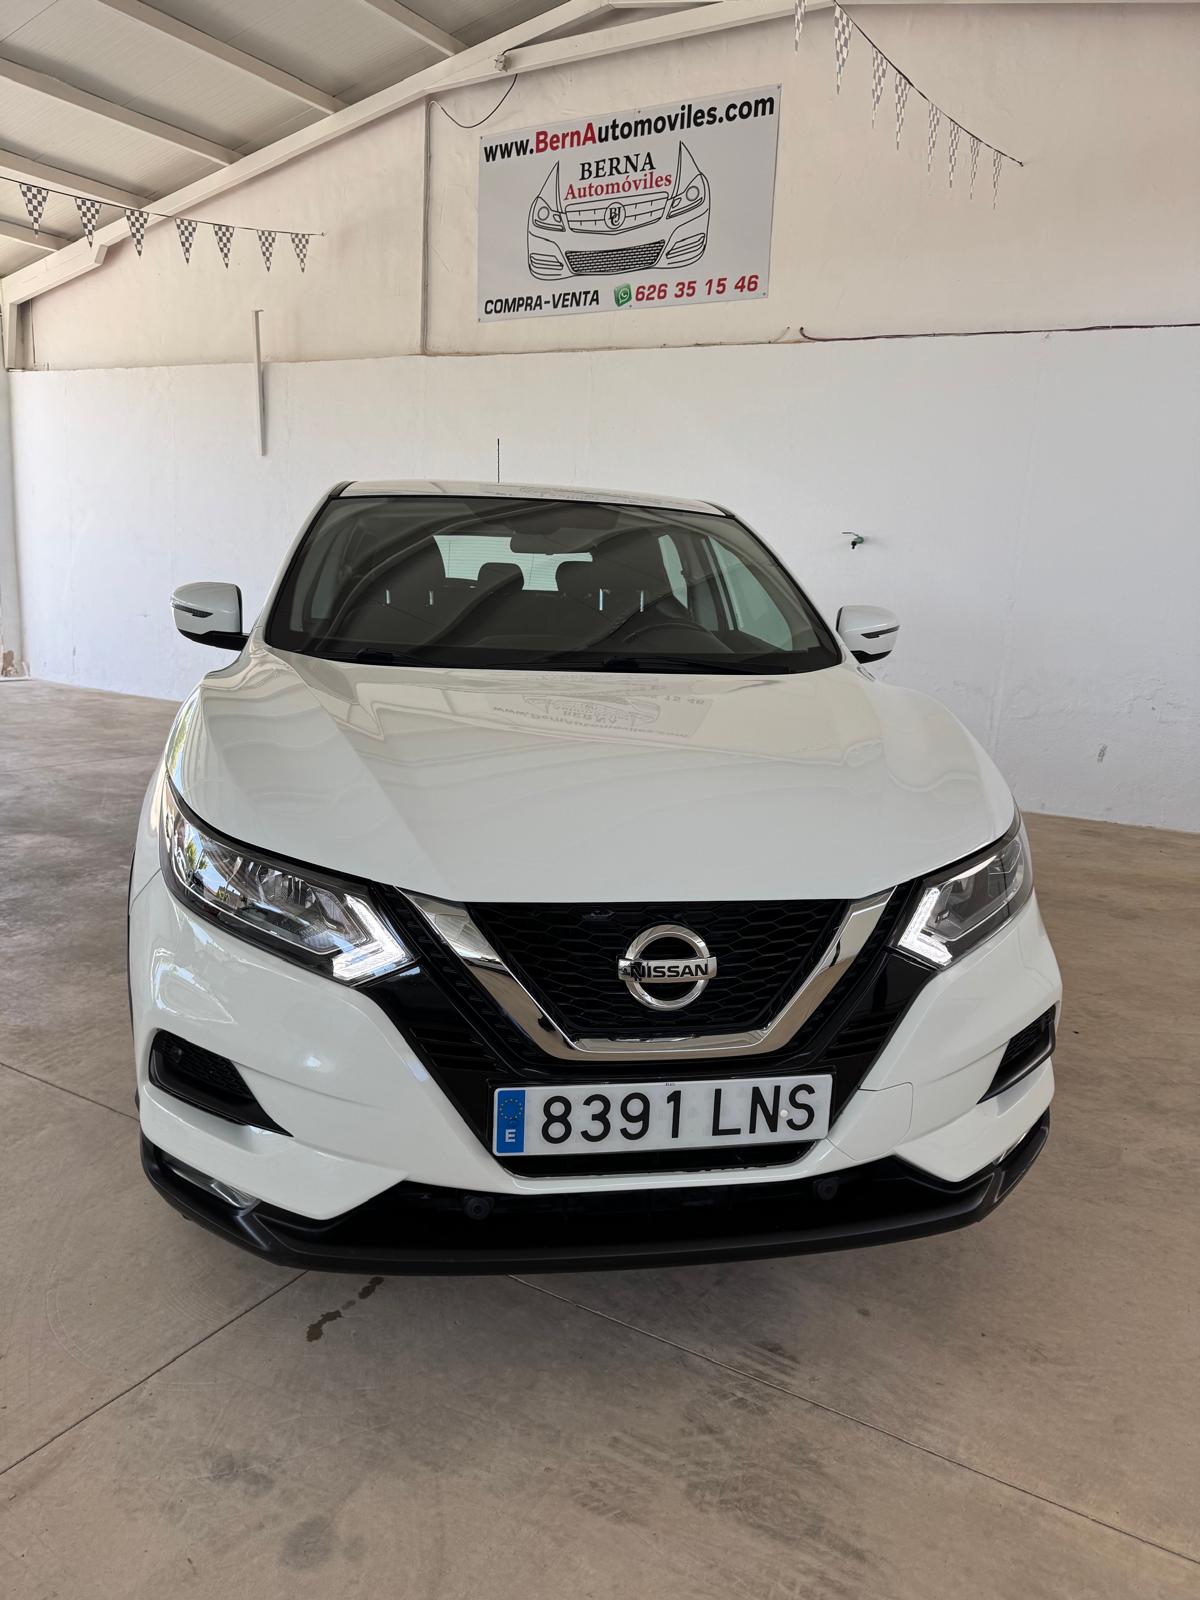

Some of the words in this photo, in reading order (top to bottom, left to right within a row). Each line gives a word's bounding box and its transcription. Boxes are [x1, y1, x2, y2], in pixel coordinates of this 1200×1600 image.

[484, 96, 775, 162] www.BernAutomoviles.com
[579, 152, 656, 180] BERNA
[563, 172, 672, 200] Automóviles
[635, 283, 667, 301] 626
[674, 280, 696, 298] 35
[705, 278, 726, 295] 15
[734, 275, 759, 292] 46
[484, 290, 600, 314] COMPRA-VENTA
[630, 963, 708, 979] NISSAN
[541, 1090, 682, 1144] 8391
[711, 1083, 816, 1137] LNS
[505, 1129, 516, 1143] E
